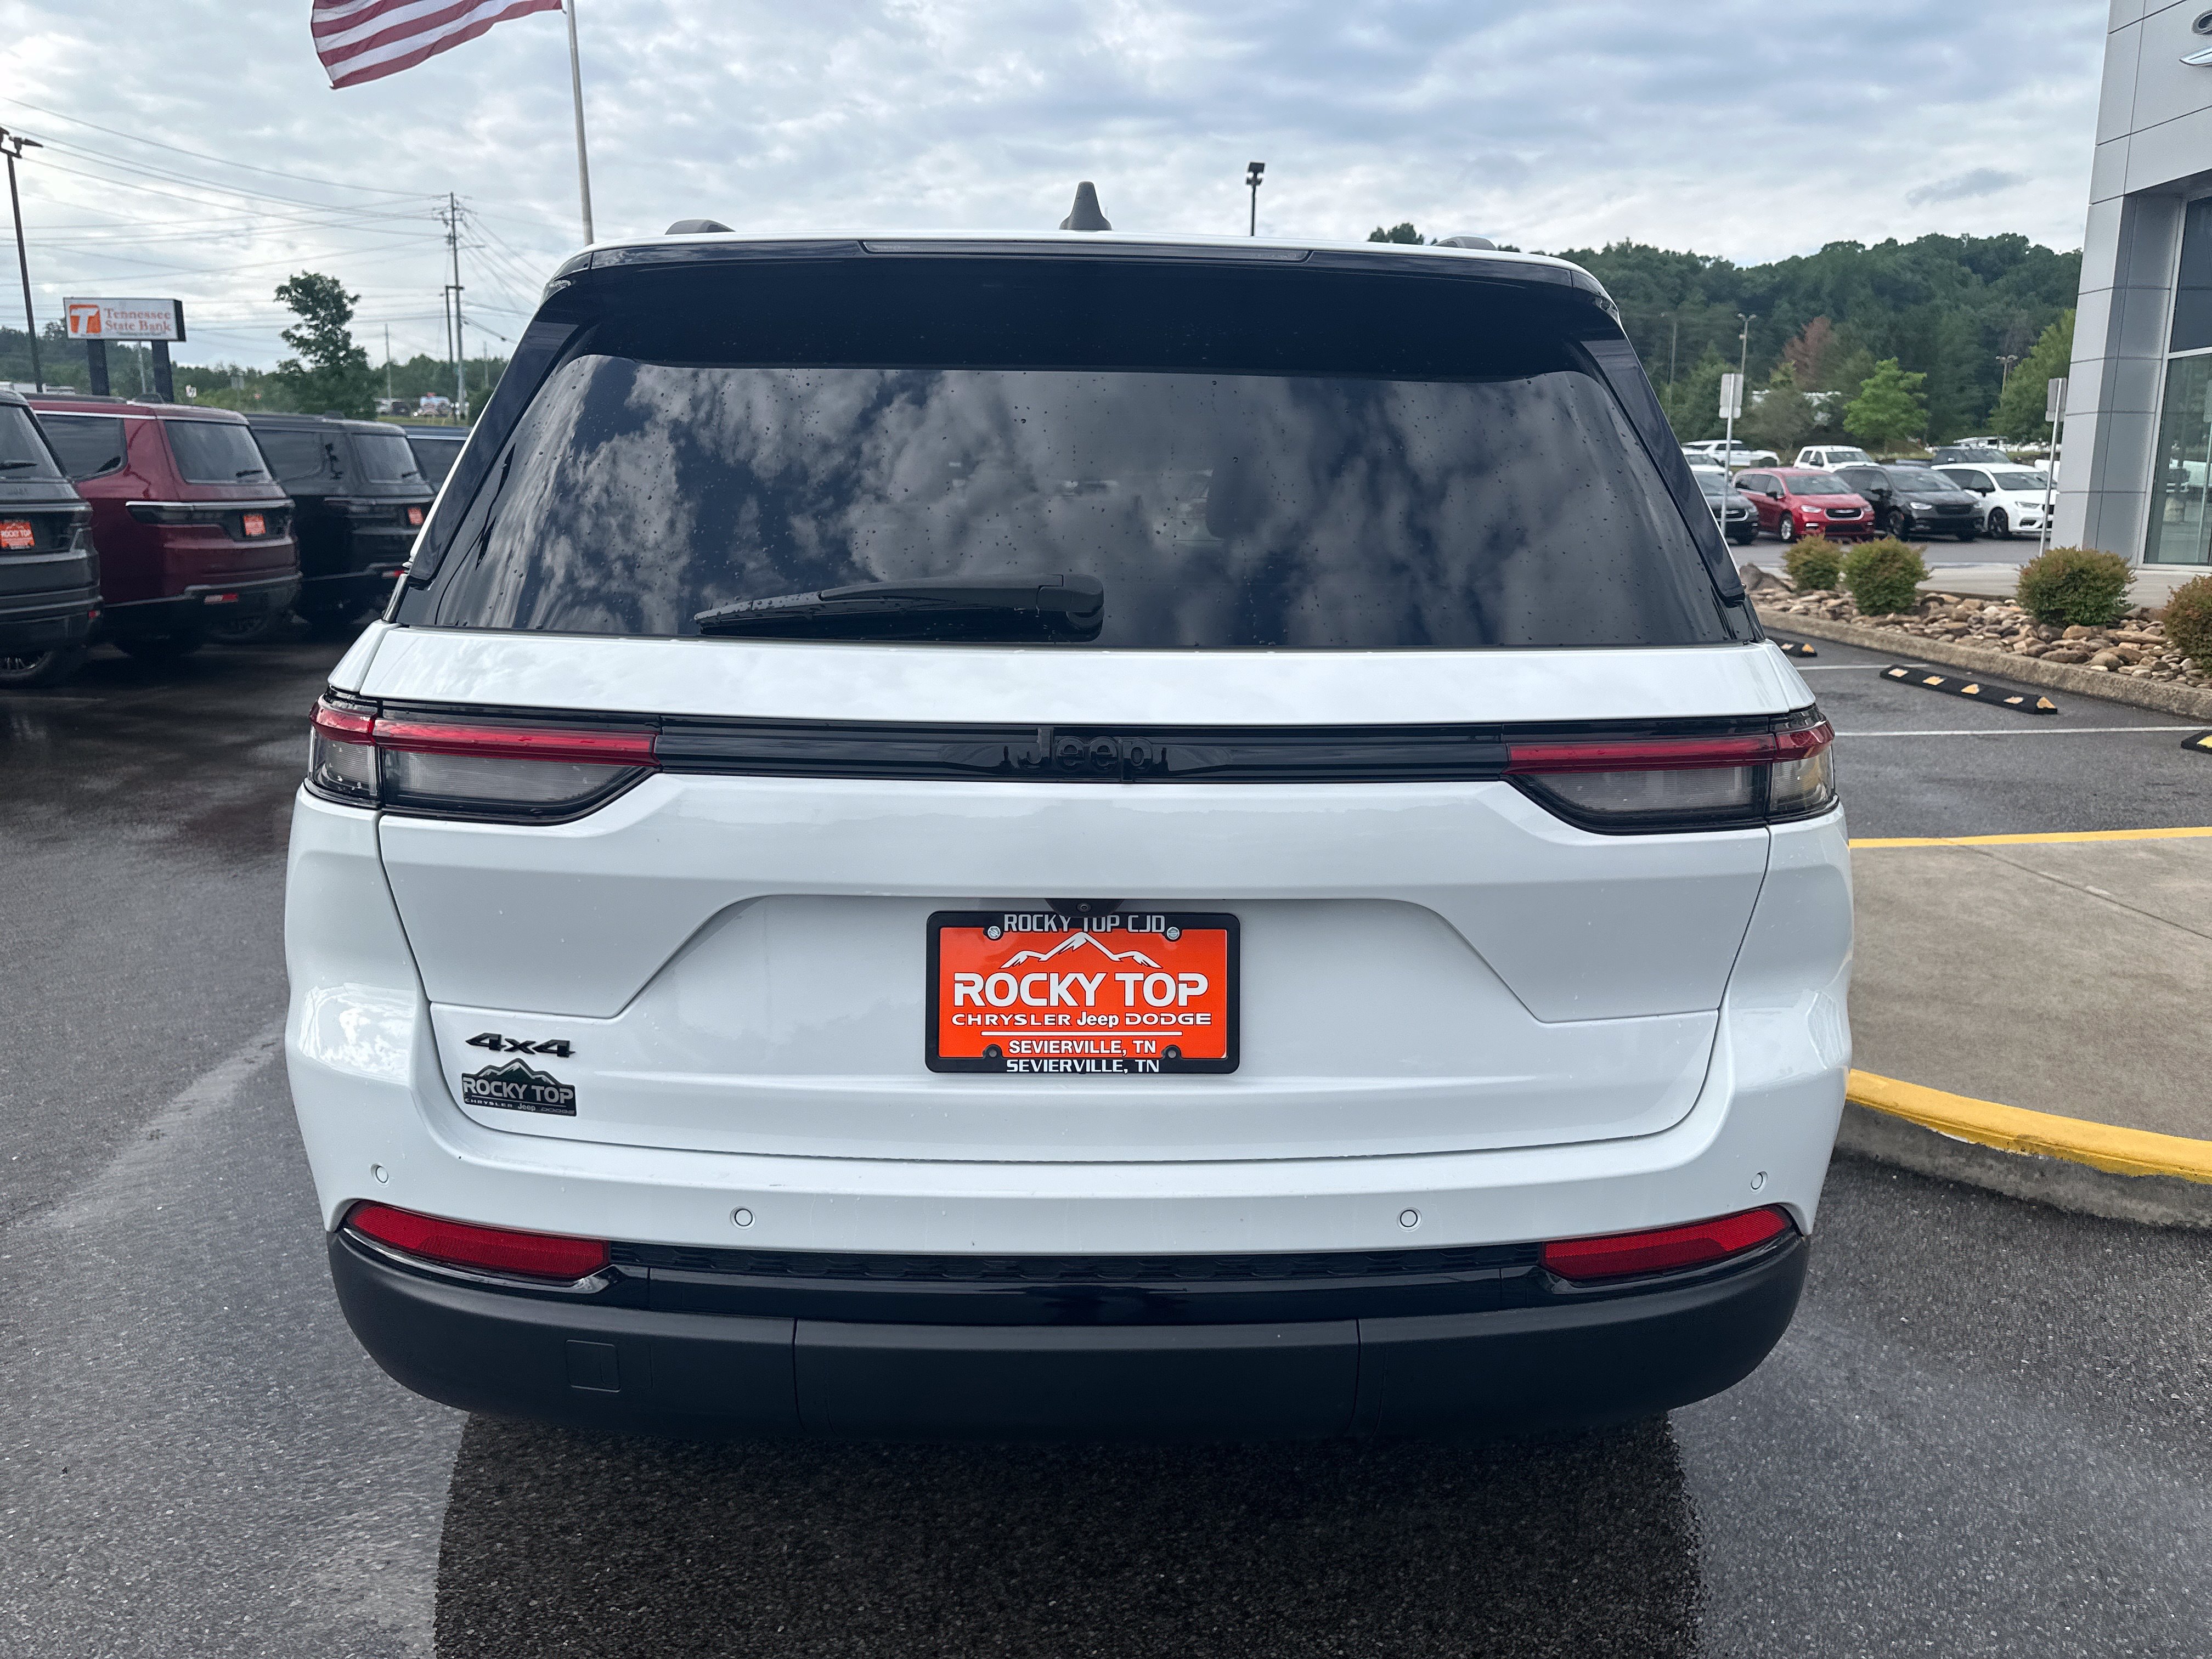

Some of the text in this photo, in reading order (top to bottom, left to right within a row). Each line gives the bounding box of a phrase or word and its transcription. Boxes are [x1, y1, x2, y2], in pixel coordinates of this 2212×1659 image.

[103, 308, 171, 319] Tennessee
[105, 319, 171, 332] State Bank
[1017, 727, 1152, 783] Jeep
[1004, 914, 1165, 933] ROCKY TOP CJD
[953, 972, 1209, 1007] ROCKY TOP
[952, 1012, 1212, 1029] CHRYSLER Jeep DODGE
[465, 1032, 575, 1058] 4x4
[1008, 1040, 1156, 1057] SEVIERVILLE, TN
[1006, 1059, 1159, 1074] SEVIERVILLE, TN
[462, 1077, 574, 1104] ROCKY TOP
[465, 1098, 514, 1108] CHRYSLER
[517, 1103, 536, 1112] Jeep
